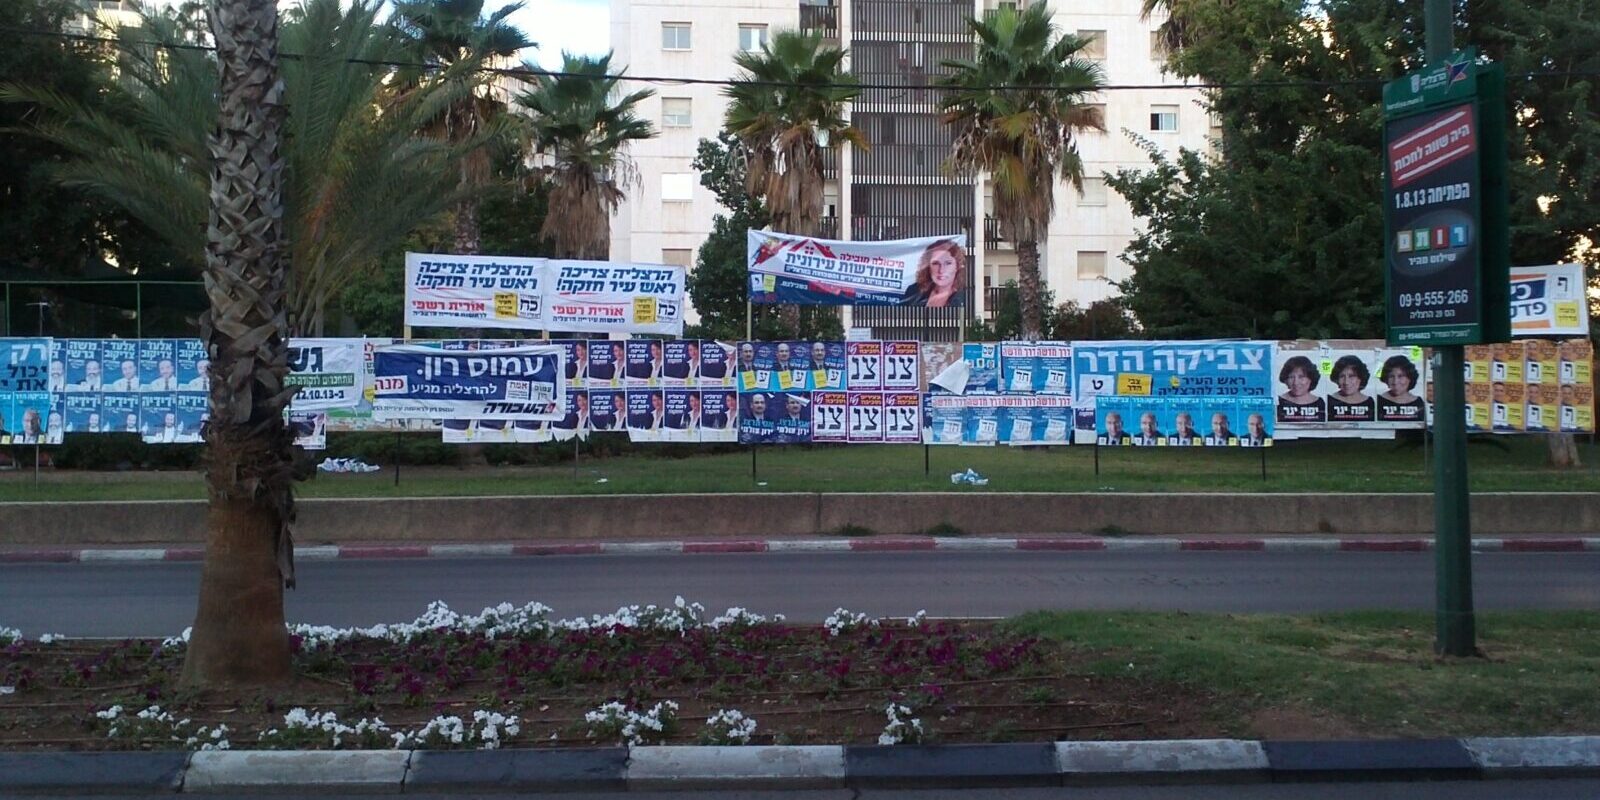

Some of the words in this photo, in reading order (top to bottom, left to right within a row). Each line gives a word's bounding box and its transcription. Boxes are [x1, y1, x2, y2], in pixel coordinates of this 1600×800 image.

[1450, 124, 1470, 143] היה
[1425, 135, 1449, 155] שווה
[1394, 146, 1423, 172] לחכות
[1395, 189, 1425, 209] 1.8.13
[1427, 182, 1470, 204] הפתיחה
[785, 253, 835, 269] עירונית
[840, 253, 869, 263] מובילה
[873, 256, 904, 268] מיכאלה
[420, 261, 469, 274] צריכה
[472, 262, 533, 276] הרצליה
[560, 266, 609, 279] צריכה
[613, 267, 673, 280] הרצליה
[838, 262, 903, 280] התחדשות
[415, 274, 465, 290] חזקה!
[469, 277, 496, 288] עיר
[500, 278, 537, 290] ראש
[556, 278, 605, 294] חזקה!
[610, 281, 636, 292] עיר
[640, 282, 677, 294] ראש
[412, 300, 445, 310] רשפי
[449, 301, 485, 312] אורית
[520, 299, 538, 311] כח
[552, 305, 584, 315] רשפי
[588, 305, 624, 316] אורית
[659, 303, 675, 315] כח
[1410, 309, 1433, 319] הרצליה
[69, 341, 97, 350] משה
[111, 341, 135, 351] אלעד
[147, 341, 172, 351] אלעד
[185, 340, 203, 351] לעד
[11, 344, 47, 365] רק
[67, 350, 95, 358] גרשי
[104, 350, 135, 360] צדיקוב
[142, 350, 172, 360] צדיקוב
[1078, 350, 1144, 372] הדר
[1153, 349, 1264, 375] צביקה
[7, 364, 48, 378] יכול
[417, 357, 460, 380] רון.
[467, 357, 543, 378] עמוס
[851, 356, 877, 379] צנ
[888, 356, 913, 379] צנ
[16, 379, 47, 391] את
[1092, 379, 1103, 390] ט
[1181, 376, 1213, 385] העיר
[1217, 376, 1245, 385] ראש
[411, 384, 440, 394] מגיע
[444, 383, 497, 394] להרצליה
[1158, 386, 1212, 396] להרצליה
[1217, 387, 1238, 395] טוב
[1244, 387, 1264, 395] הכי
[67, 396, 101, 408] ידידיה
[104, 396, 138, 408] ידידיה
[178, 396, 208, 407] דידיה
[1301, 406, 1319, 415] יפה
[1351, 406, 1368, 415] יפה
[1400, 406, 1418, 415] יפה
[817, 406, 843, 430] צנ
[853, 407, 878, 430] צנ
[890, 407, 915, 431] צנ
